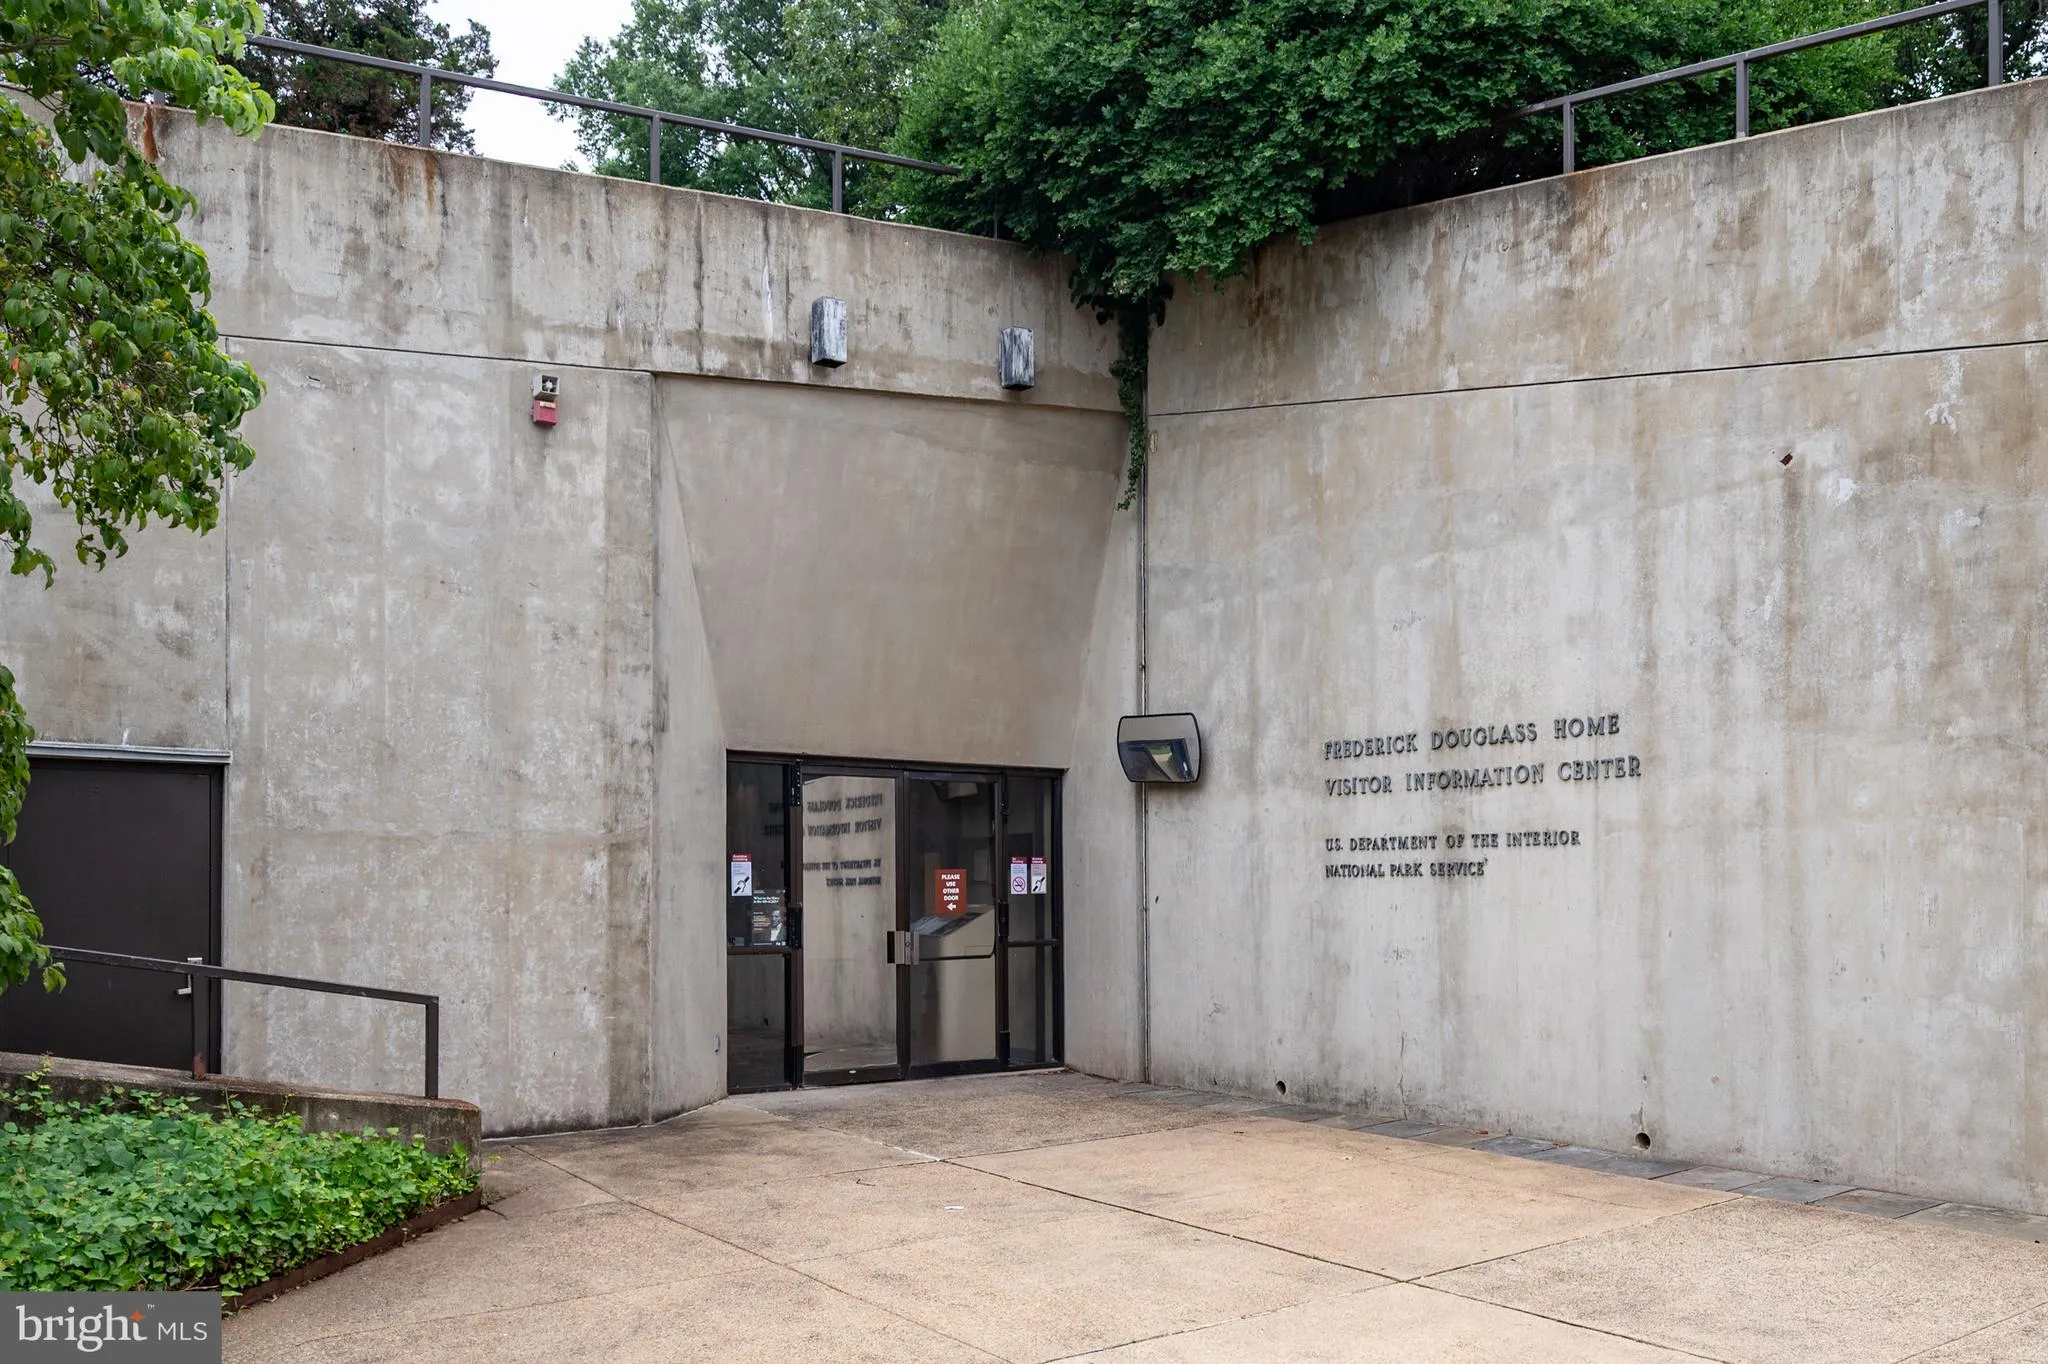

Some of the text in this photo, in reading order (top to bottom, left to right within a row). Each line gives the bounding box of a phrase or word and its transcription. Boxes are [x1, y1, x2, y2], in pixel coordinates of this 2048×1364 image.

[1323, 712, 1620, 760] FREDERICK DOUGLASS HOME
[1324, 755, 1642, 796] VISITOR INFORMATION CENTER
[1350, 835, 1438, 851] DEPARTMENT
[1445, 834, 1465, 848] OF
[1471, 833, 1499, 848] THE
[1506, 830, 1581, 846] INTERIOR
[1325, 861, 1484, 878] NATIONAL PARK SERVICE
